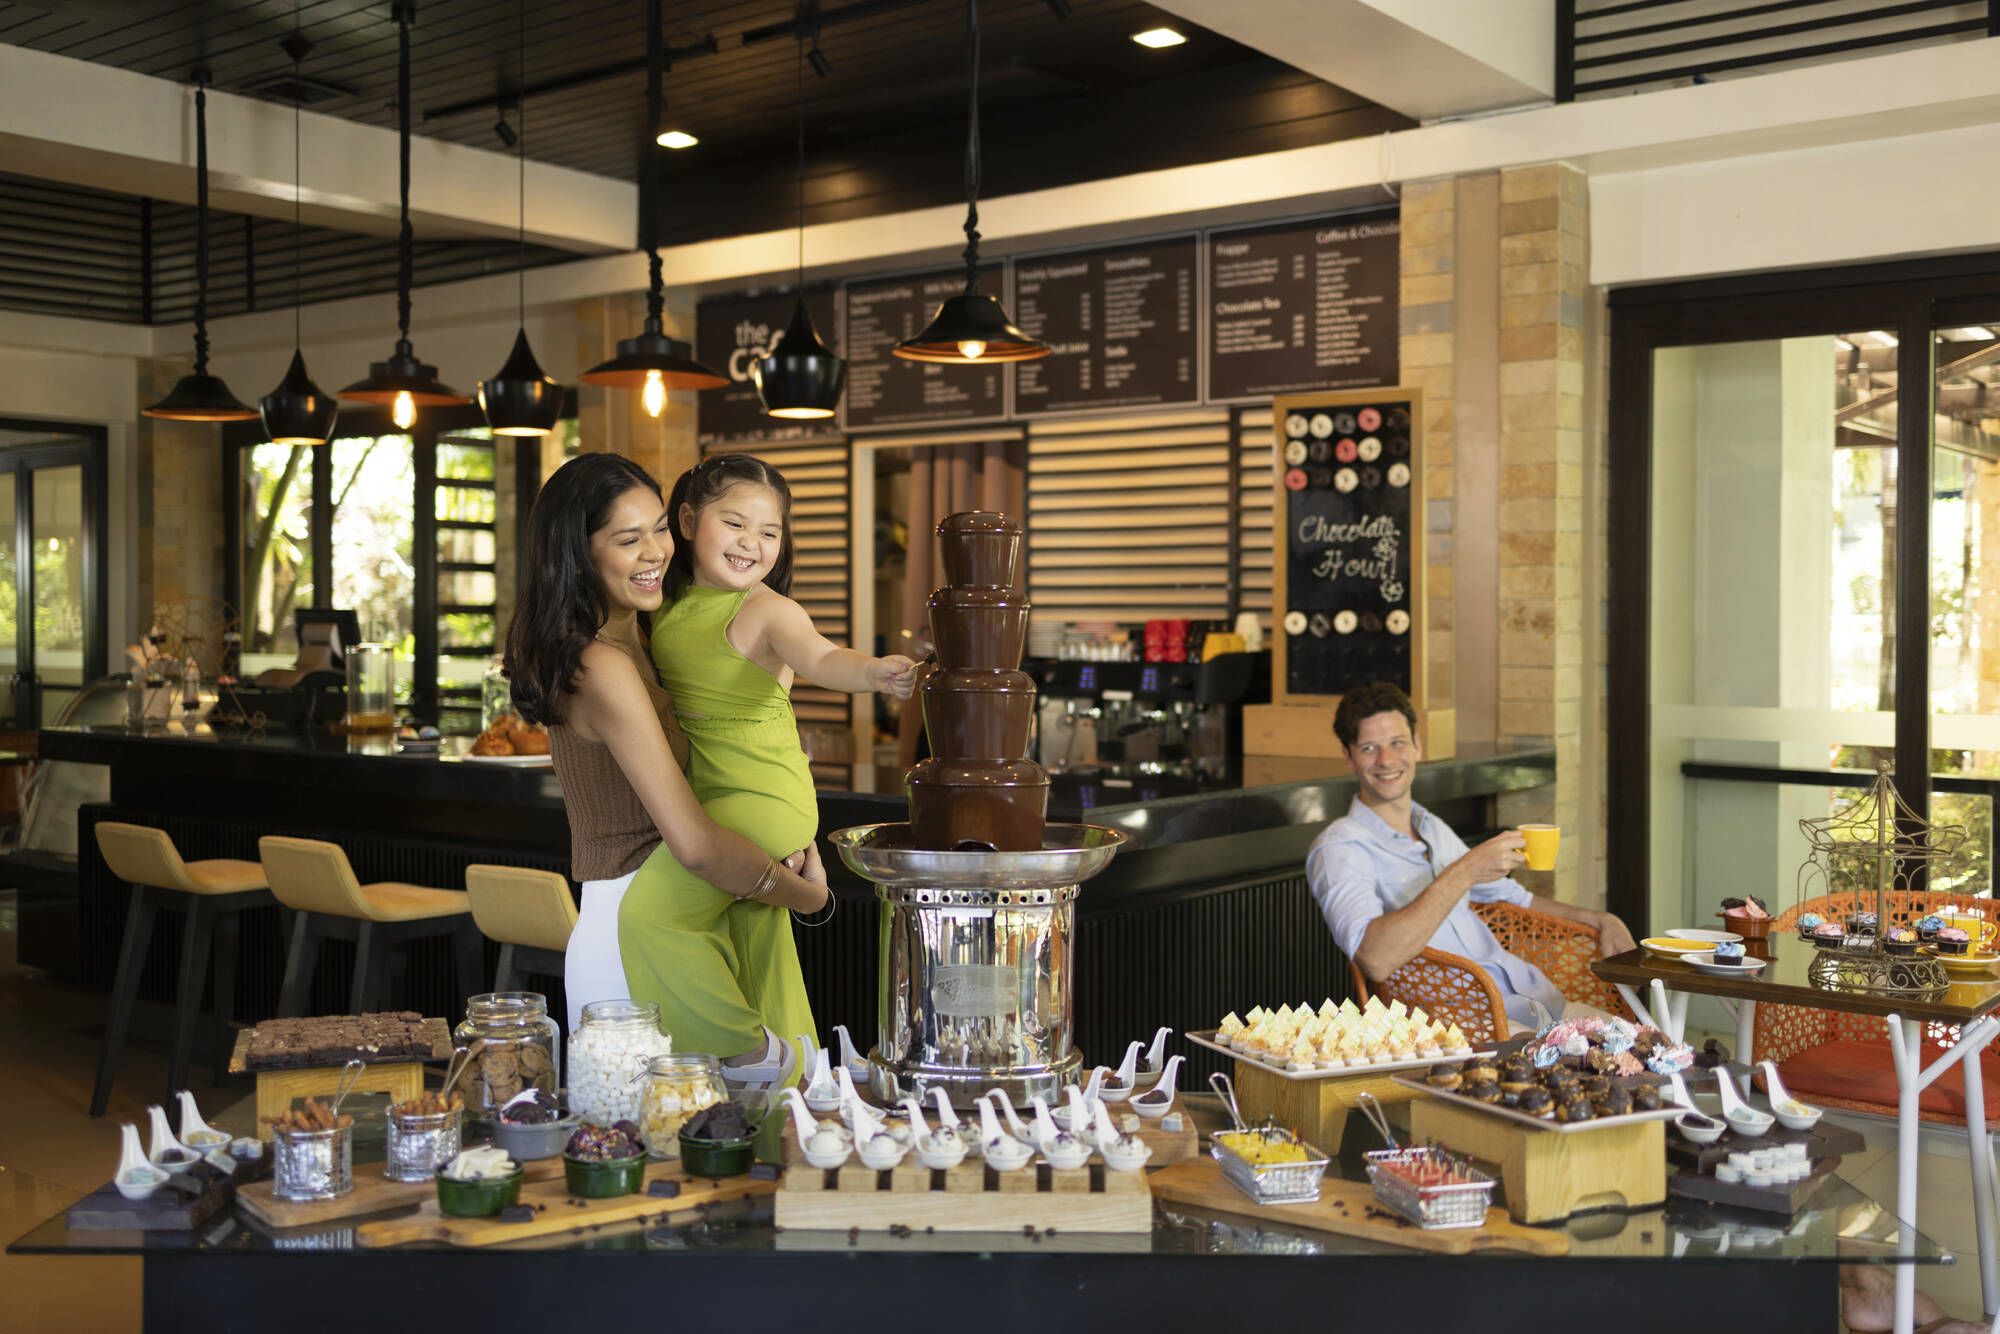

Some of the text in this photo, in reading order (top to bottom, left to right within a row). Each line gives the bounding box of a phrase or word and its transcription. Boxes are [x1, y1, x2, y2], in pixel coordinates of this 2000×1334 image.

[1315, 231, 1348, 245] Coffee
[1350, 229, 1358, 240] &
[1215, 243, 1250, 256] Frappe
[1104, 257, 1151, 272] Smoothies
[1215, 297, 1282, 316] Chocolate Tea
[735, 319, 769, 345] the
[1298, 514, 1400, 542] Chocolate
